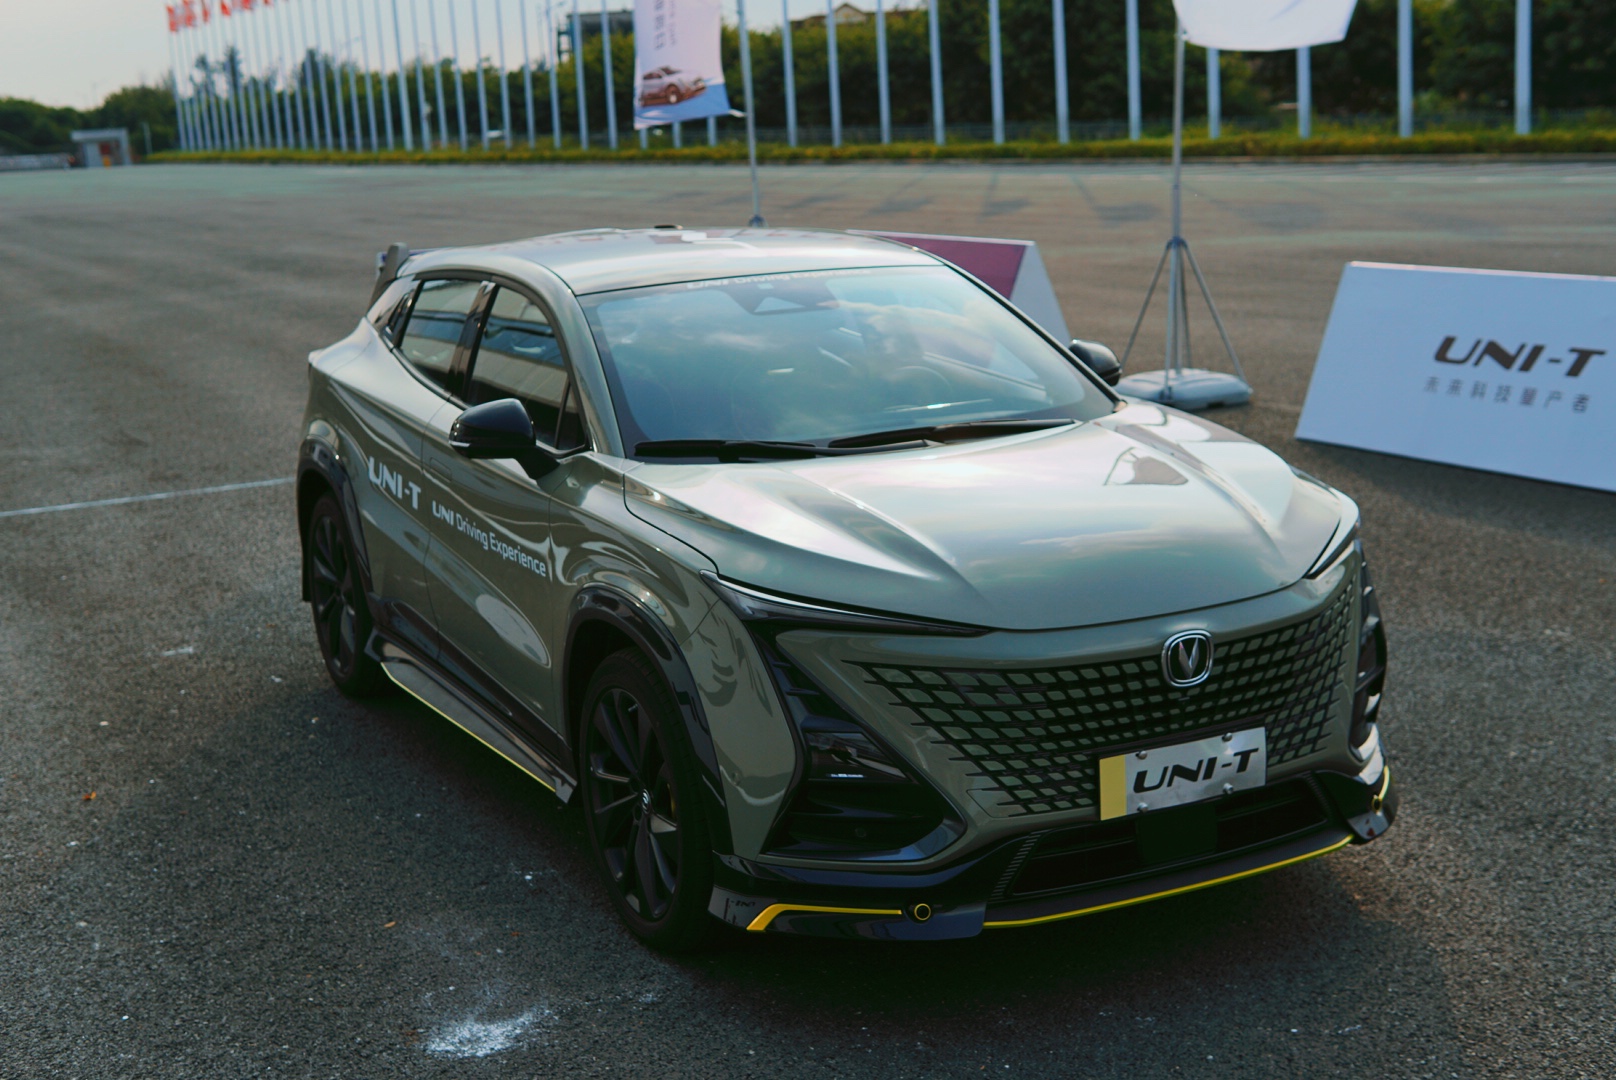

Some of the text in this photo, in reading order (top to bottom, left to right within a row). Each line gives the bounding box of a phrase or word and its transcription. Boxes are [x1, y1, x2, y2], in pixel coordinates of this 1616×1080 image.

[1434, 335, 1607, 378] UNI-T
[367, 456, 422, 511] UNI-T
[432, 500, 547, 578] UNI Driving Experience
[1133, 747, 1260, 794] UNI-T
